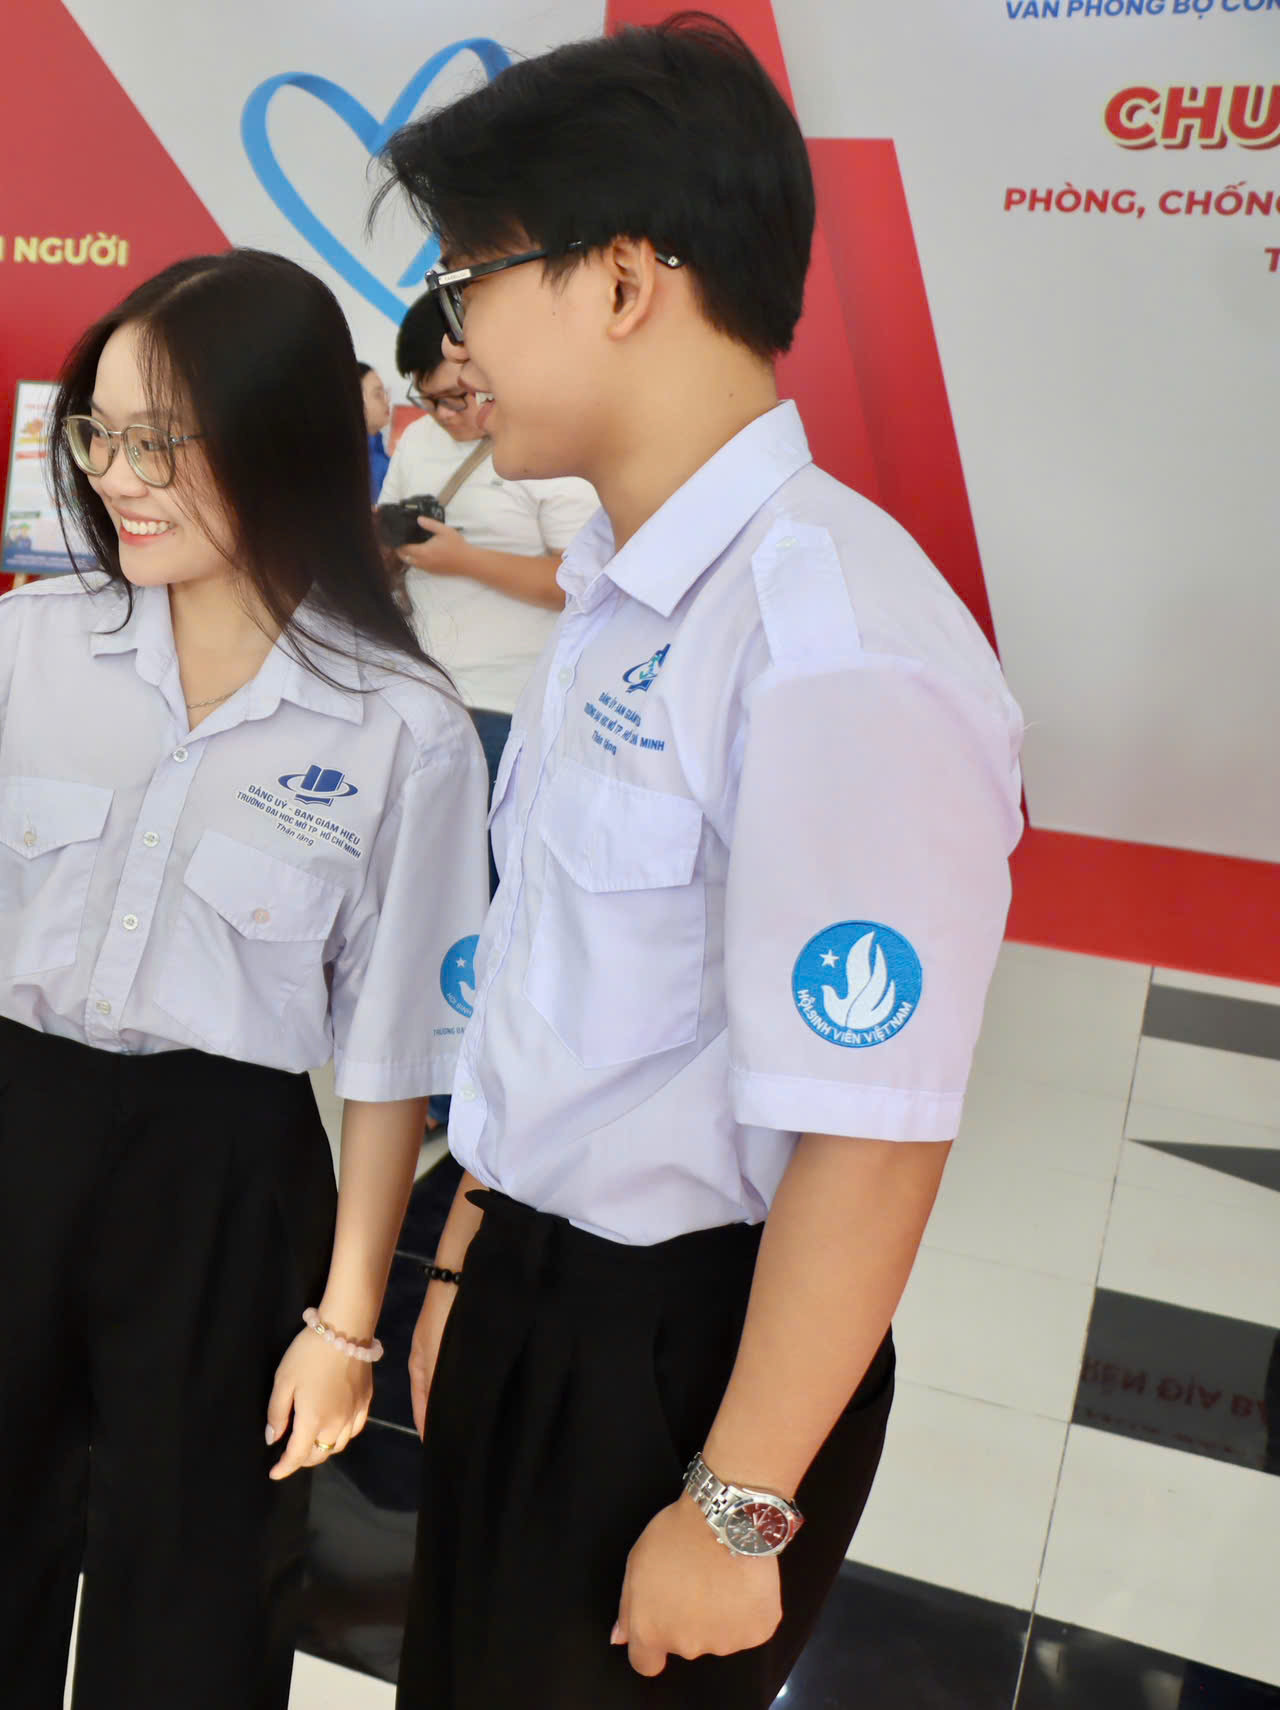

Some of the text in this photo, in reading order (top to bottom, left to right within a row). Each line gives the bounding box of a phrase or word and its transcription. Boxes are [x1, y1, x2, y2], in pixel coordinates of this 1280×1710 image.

[1004, 181, 1280, 219] PHÒNG, CHỐN
[14, 231, 129, 267] NGƯỜI
[639, 736, 665, 751] MINH
[279, 812, 294, 825] HỌC
[332, 834, 344, 849] CHÍ
[344, 842, 362, 859] MINH
[294, 808, 314, 822] BAN
[315, 815, 340, 833] GIÁM
[340, 827, 361, 846] HIỆU
[797, 988, 913, 1045] HỘI SINH VIÊN VIỆT NAM
